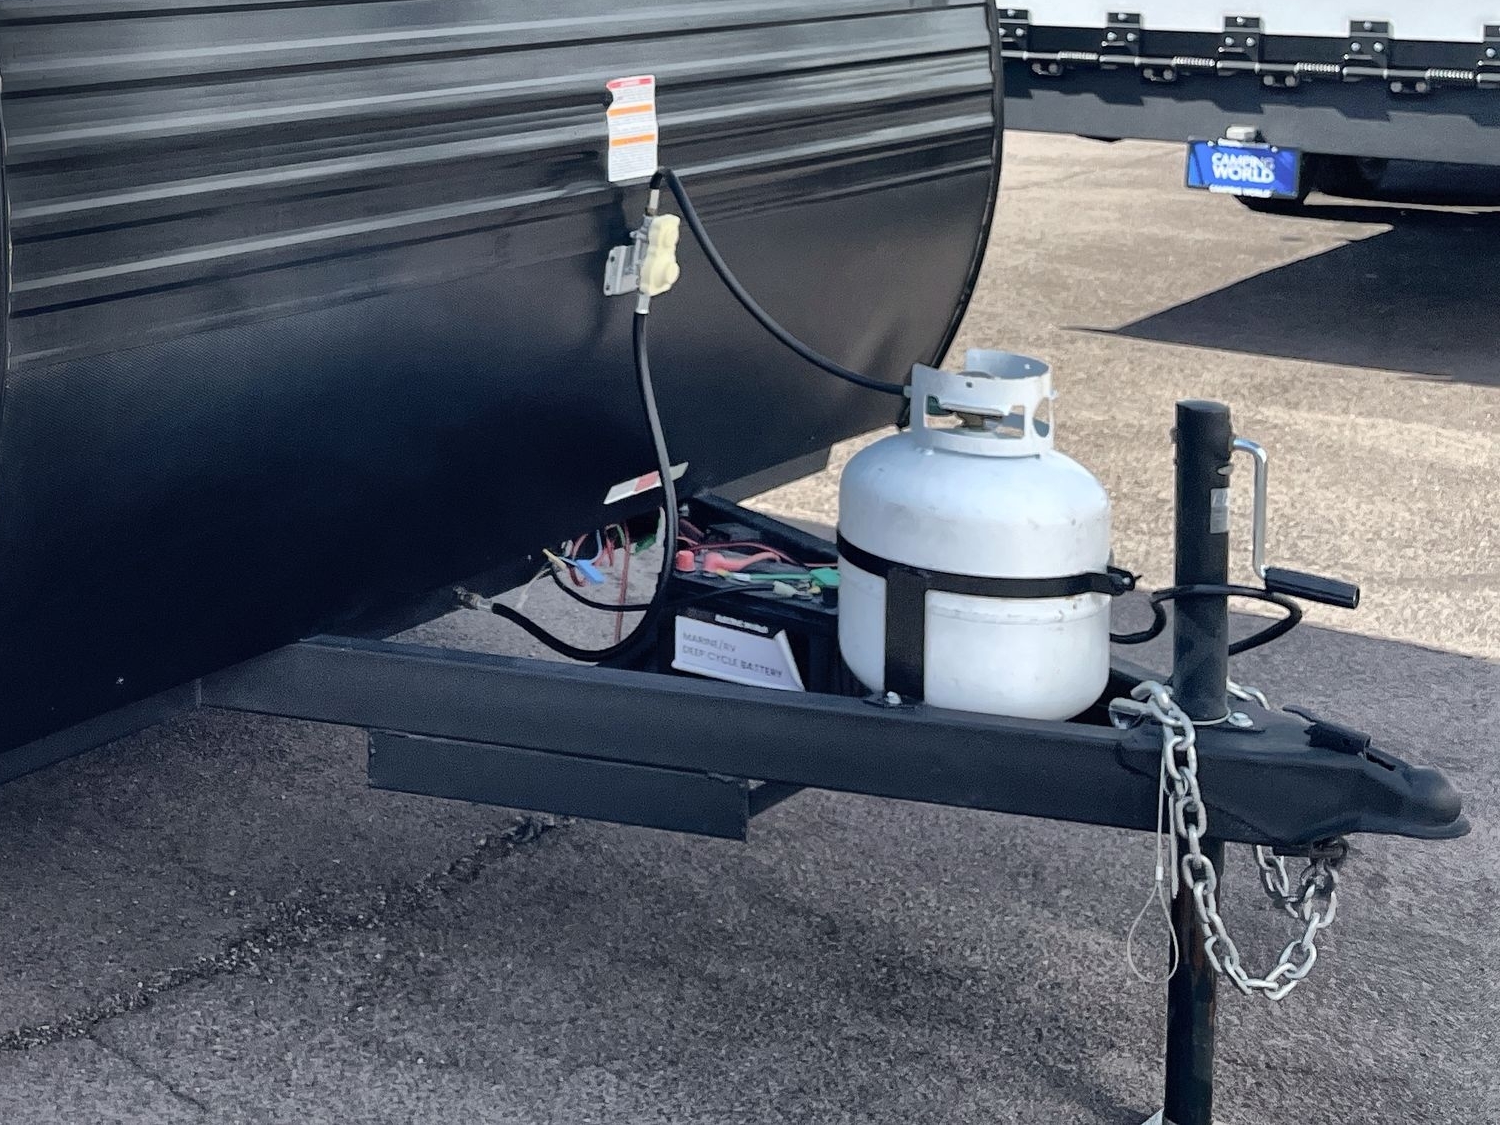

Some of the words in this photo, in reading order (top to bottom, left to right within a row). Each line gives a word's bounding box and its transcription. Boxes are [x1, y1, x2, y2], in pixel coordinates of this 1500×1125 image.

[1212, 164, 1276, 184] WORLD
[682, 644, 706, 657] DEEP
[707, 651, 738, 668] CYCLE
[740, 660, 783, 678] BATTERY
